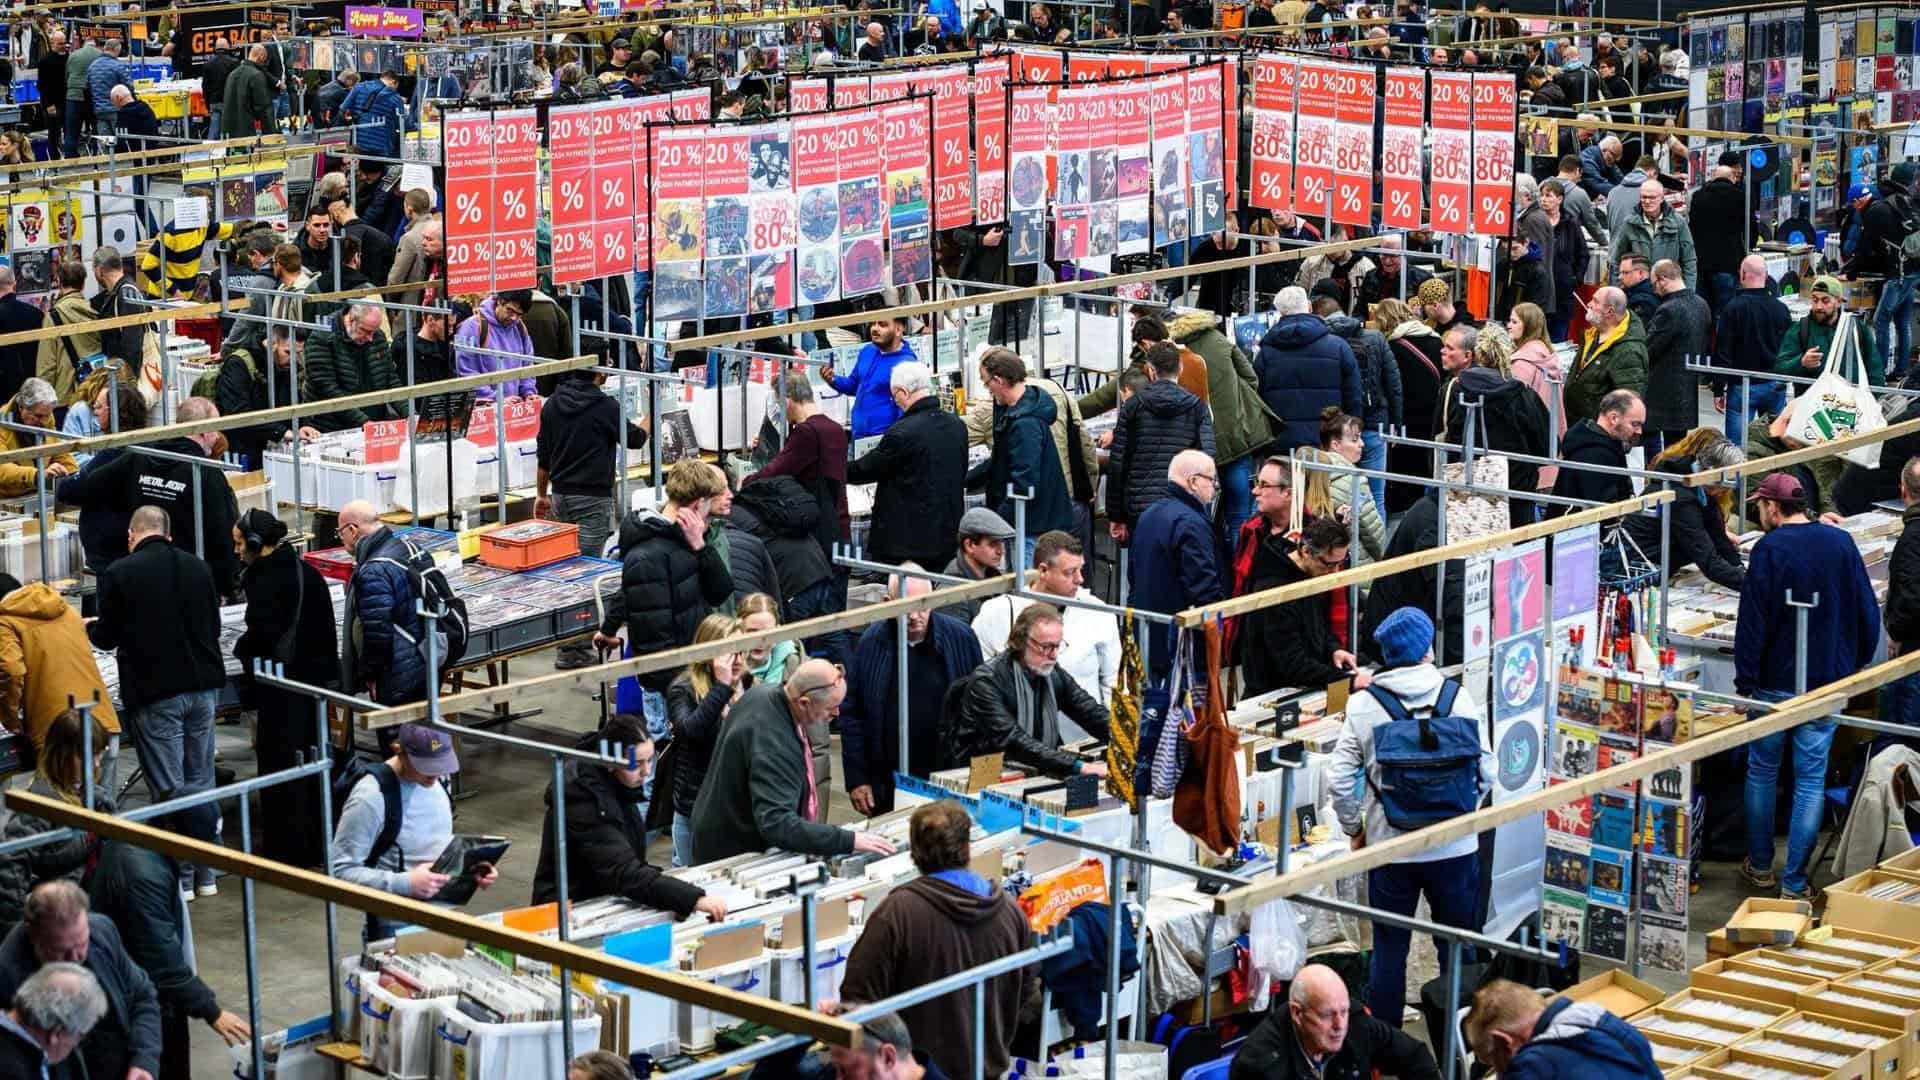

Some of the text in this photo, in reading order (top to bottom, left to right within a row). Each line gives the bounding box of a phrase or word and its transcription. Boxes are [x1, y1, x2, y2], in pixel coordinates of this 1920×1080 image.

[976, 76, 992, 94] 20
[1257, 65, 1293, 86] 20 %
[1300, 71, 1336, 90] 20 %
[1338, 77, 1374, 96] 20 %
[836, 90, 852, 107] 20
[937, 81, 952, 100] 20
[1190, 86, 1206, 104] 20
[1386, 80, 1422, 100] 20 %
[1432, 84, 1470, 103] 20 %
[1474, 86, 1512, 104] 20 %
[673, 104, 692, 120] 20
[794, 92, 811, 112] 20
[1014, 103, 1030, 122] 20
[1058, 104, 1074, 122] 20
[1089, 100, 1106, 120] 20
[1118, 98, 1134, 116] 20
[1152, 92, 1168, 112] 20
[496, 122, 536, 144] 20 %
[552, 118, 590, 139] 20 %
[594, 112, 630, 135] 20 %
[887, 118, 924, 140] 20 %
[448, 126, 490, 148] 20 %
[798, 132, 836, 155] 20 %
[840, 125, 878, 150] 20 %
[984, 132, 1001, 160] %
[660, 144, 702, 168] 20 %
[706, 141, 748, 164] 20 %
[944, 136, 962, 167] %
[561, 179, 584, 212] %
[602, 176, 624, 210] %
[940, 184, 956, 202] 20
[1260, 172, 1282, 200] %
[1304, 176, 1324, 204] %
[456, 191, 482, 225] %
[503, 188, 526, 221] %
[1341, 184, 1362, 212] %
[1390, 190, 1412, 218] %
[1438, 194, 1460, 222] %
[1482, 196, 1505, 225] %
[554, 230, 593, 253] 20 %
[754, 222, 794, 250] 80%
[448, 242, 490, 265] 20 %
[496, 236, 535, 260] 20 %
[604, 232, 626, 263] %
[512, 405, 524, 417] 20
[373, 424, 387, 438] 20
[983, 790, 1001, 802] POP
